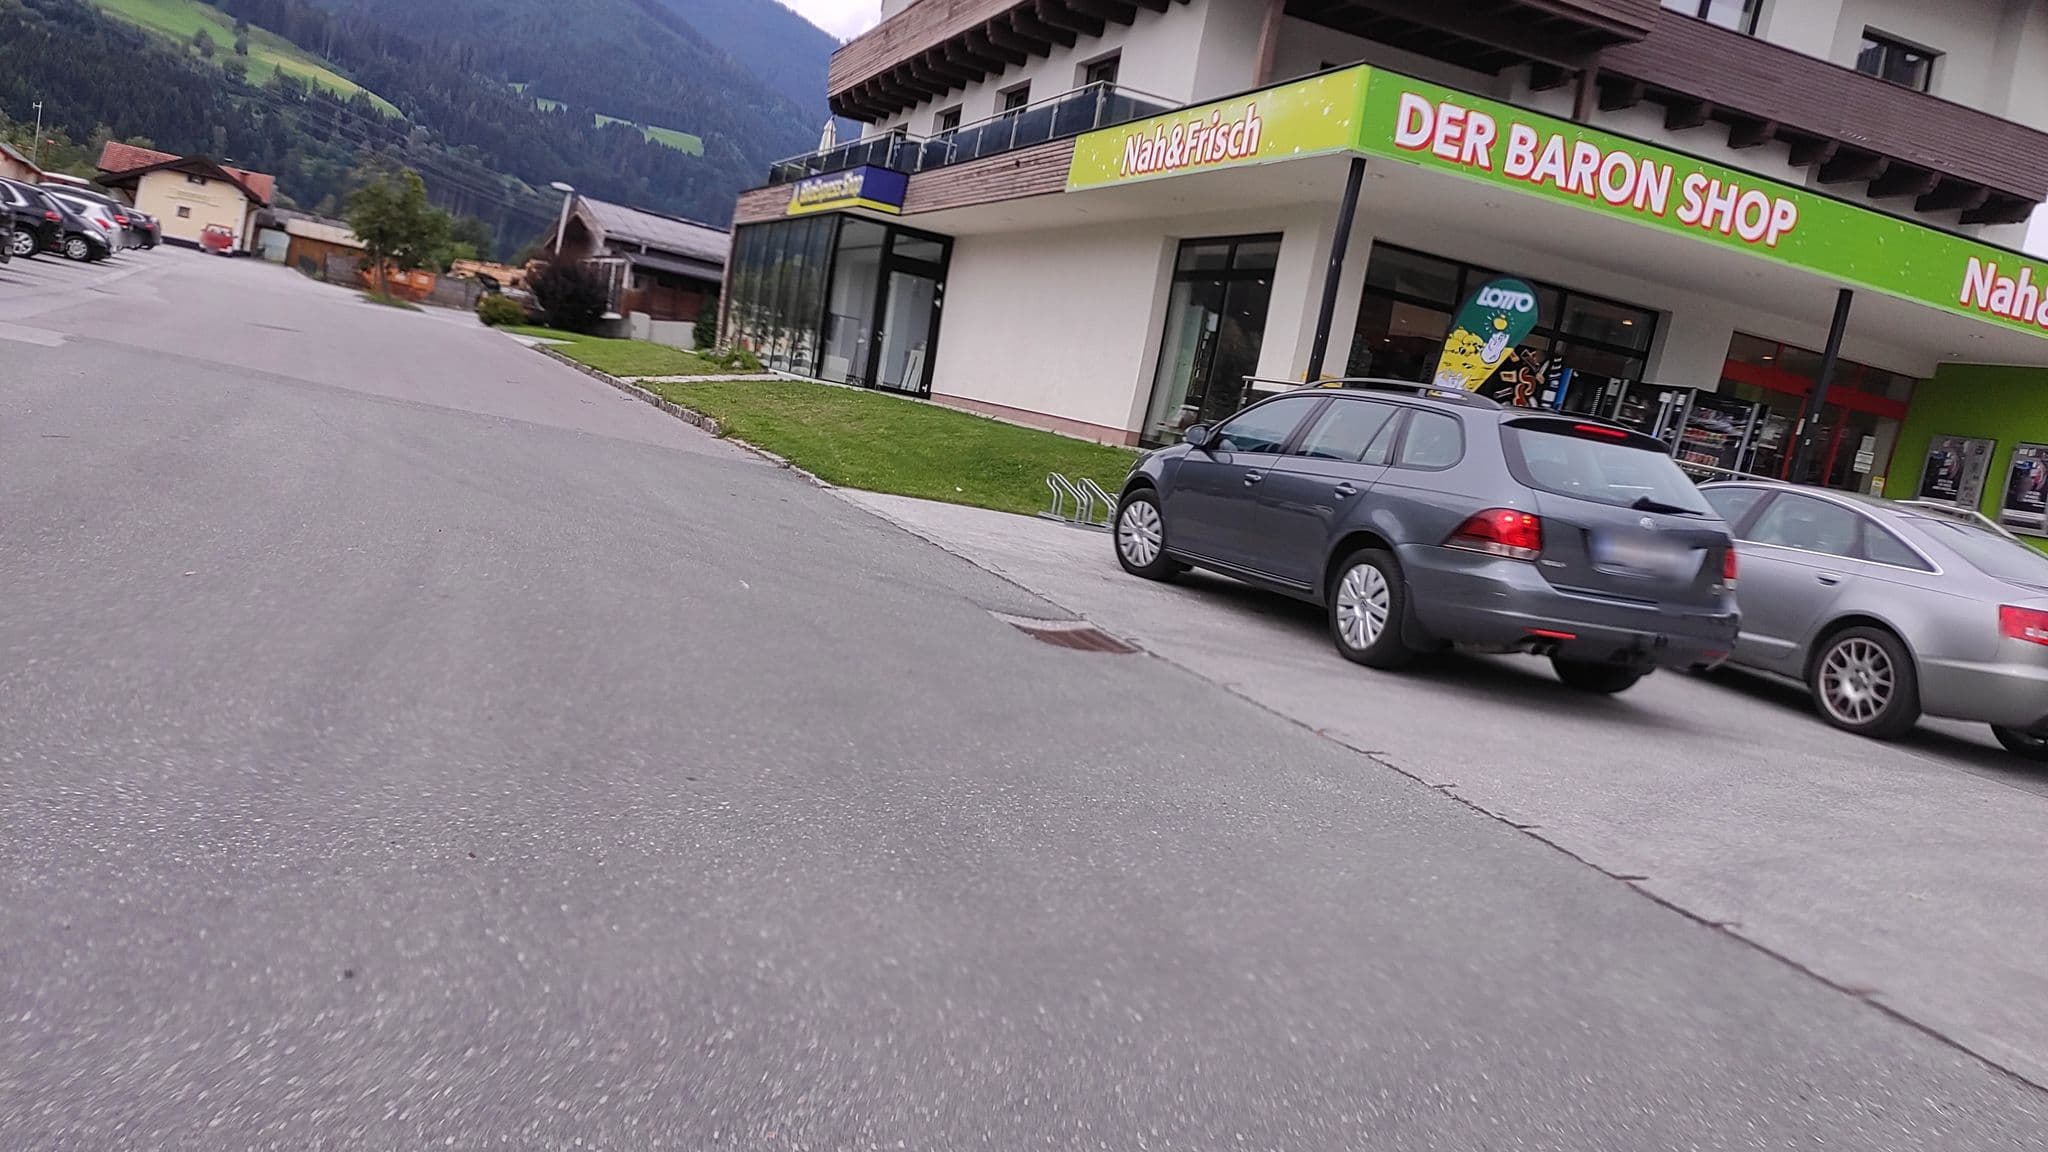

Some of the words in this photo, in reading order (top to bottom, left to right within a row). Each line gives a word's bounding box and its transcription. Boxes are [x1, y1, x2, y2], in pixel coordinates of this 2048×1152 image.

[1120, 101, 1262, 176] Nah&Frisch
[1395, 91, 1496, 171] DER
[1503, 122, 1673, 217] BARON
[1675, 172, 1798, 248] SHOP
[1476, 286, 1534, 313] LOTTO
